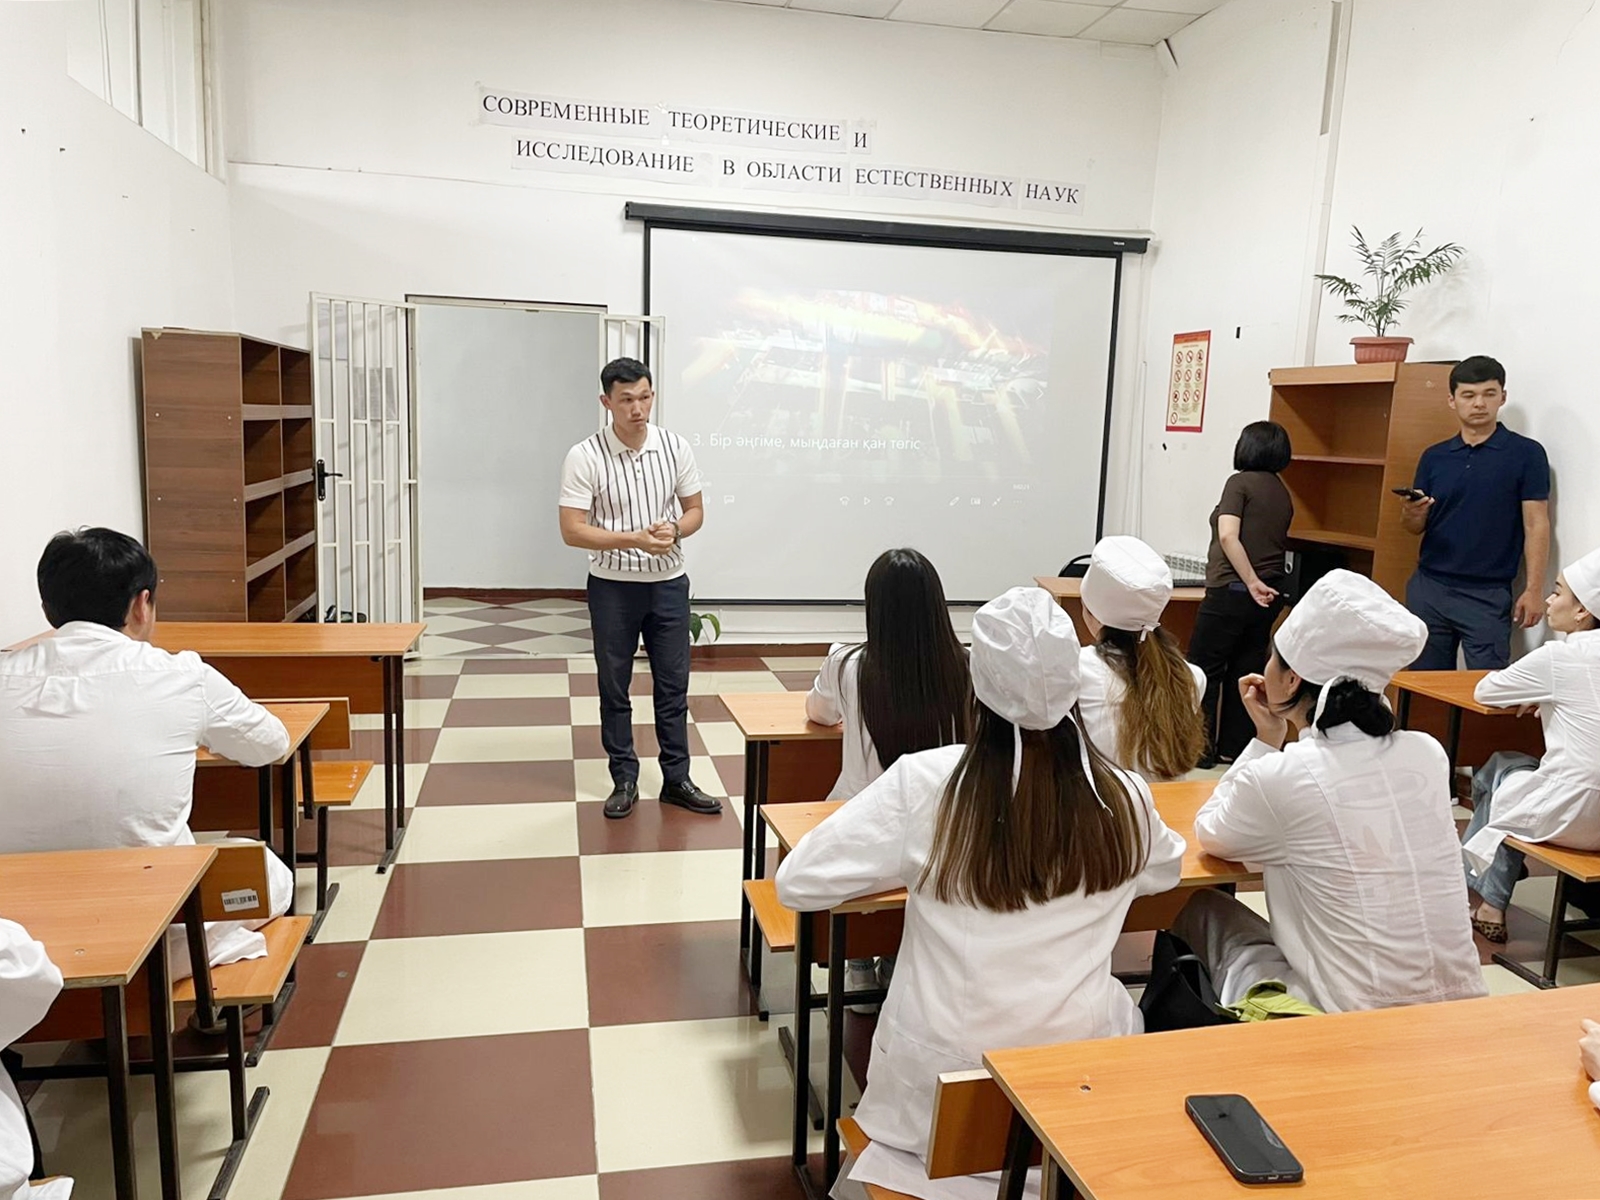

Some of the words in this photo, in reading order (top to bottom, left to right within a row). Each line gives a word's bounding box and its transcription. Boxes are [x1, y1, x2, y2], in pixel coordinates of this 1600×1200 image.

[483, 95, 651, 126] СОВРЕМЕННЫЕ
[668, 111, 840, 141] ТЕОРЕТИЧЕСКИЕ
[853, 132, 867, 148] И
[516, 139, 695, 173] ИССЛЕДОВАНИЕ
[722, 159, 736, 176] В
[746, 161, 842, 183] ОБЛАСТИ
[855, 168, 1014, 197] ЕСТЕСТВЕННЫХ
[1025, 183, 1080, 204] НАУК
[692, 433, 705, 447] 3.
[709, 432, 732, 450] Бір
[735, 434, 785, 451] әңгіме,
[790, 438, 859, 451] мыңдаған
[862, 439, 887, 452] қан
[890, 437, 921, 450] төгіс
